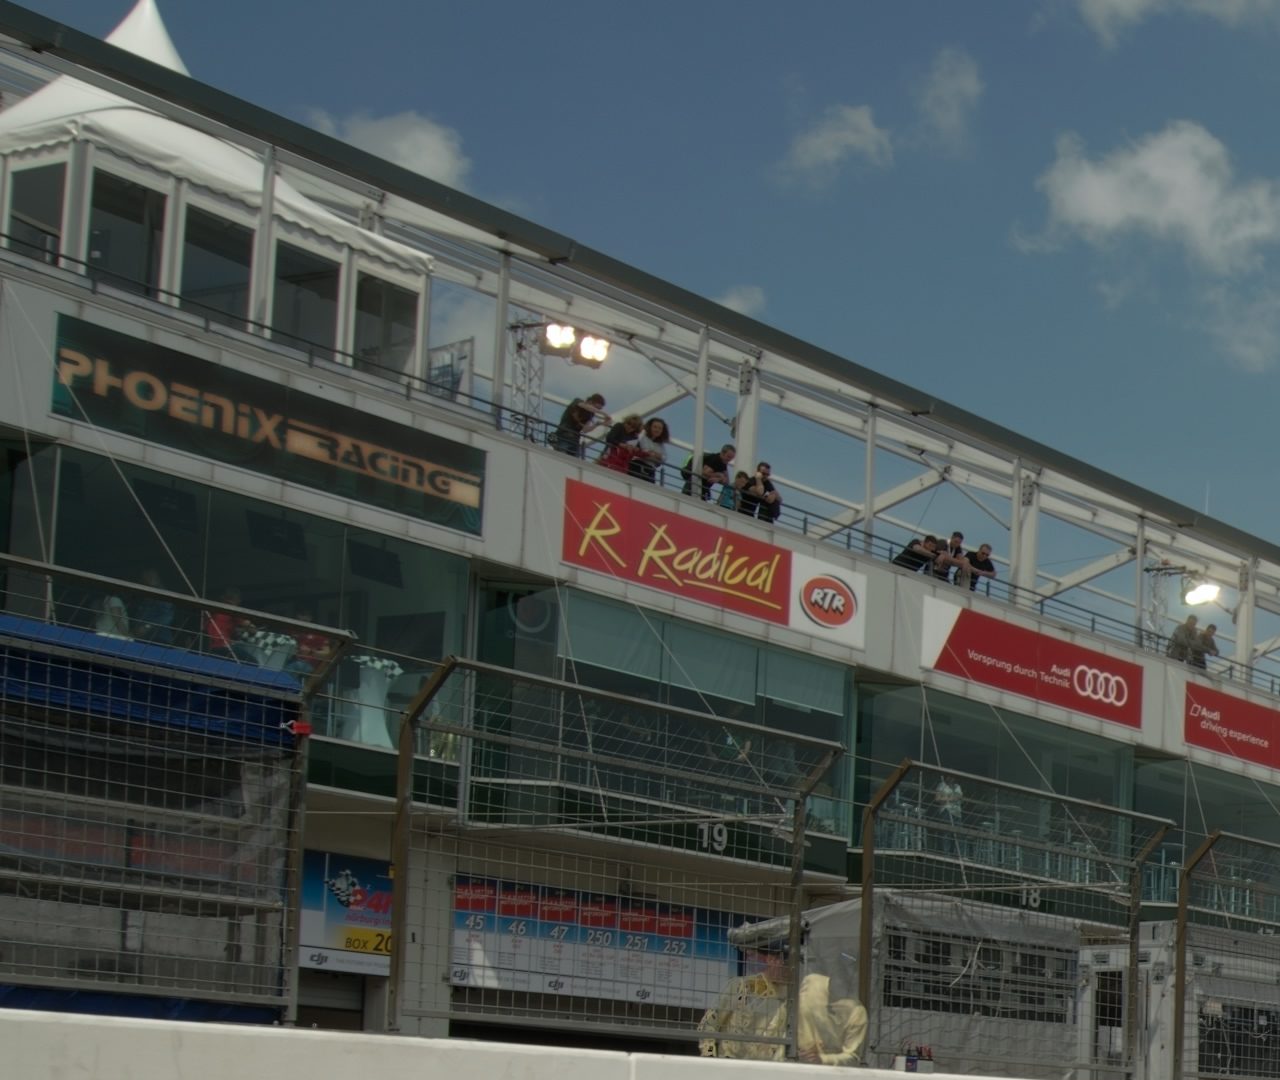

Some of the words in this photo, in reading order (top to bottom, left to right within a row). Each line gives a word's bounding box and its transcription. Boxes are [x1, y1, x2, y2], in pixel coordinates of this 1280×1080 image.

[637, 521, 781, 594] Radical
[810, 586, 846, 615] RTR
[967, 649, 1012, 673] Vorsprung
[1013, 664, 1038, 679] durch
[1040, 672, 1071, 689] Technik
[1051, 664, 1072, 677] Audi
[1200, 707, 1221, 721] Audi
[1200, 720, 1228, 738] driving
[1228, 730, 1270, 749] experience
[698, 822, 728, 852] 19
[1021, 881, 1041, 908] 18
[465, 914, 485, 930] 45
[508, 921, 527, 936] 46
[550, 926, 569, 940] 47
[586, 929, 612, 947] 250
[345, 936, 369, 950] BOX
[625, 934, 649, 951] 251
[663, 939, 688, 955] 252
